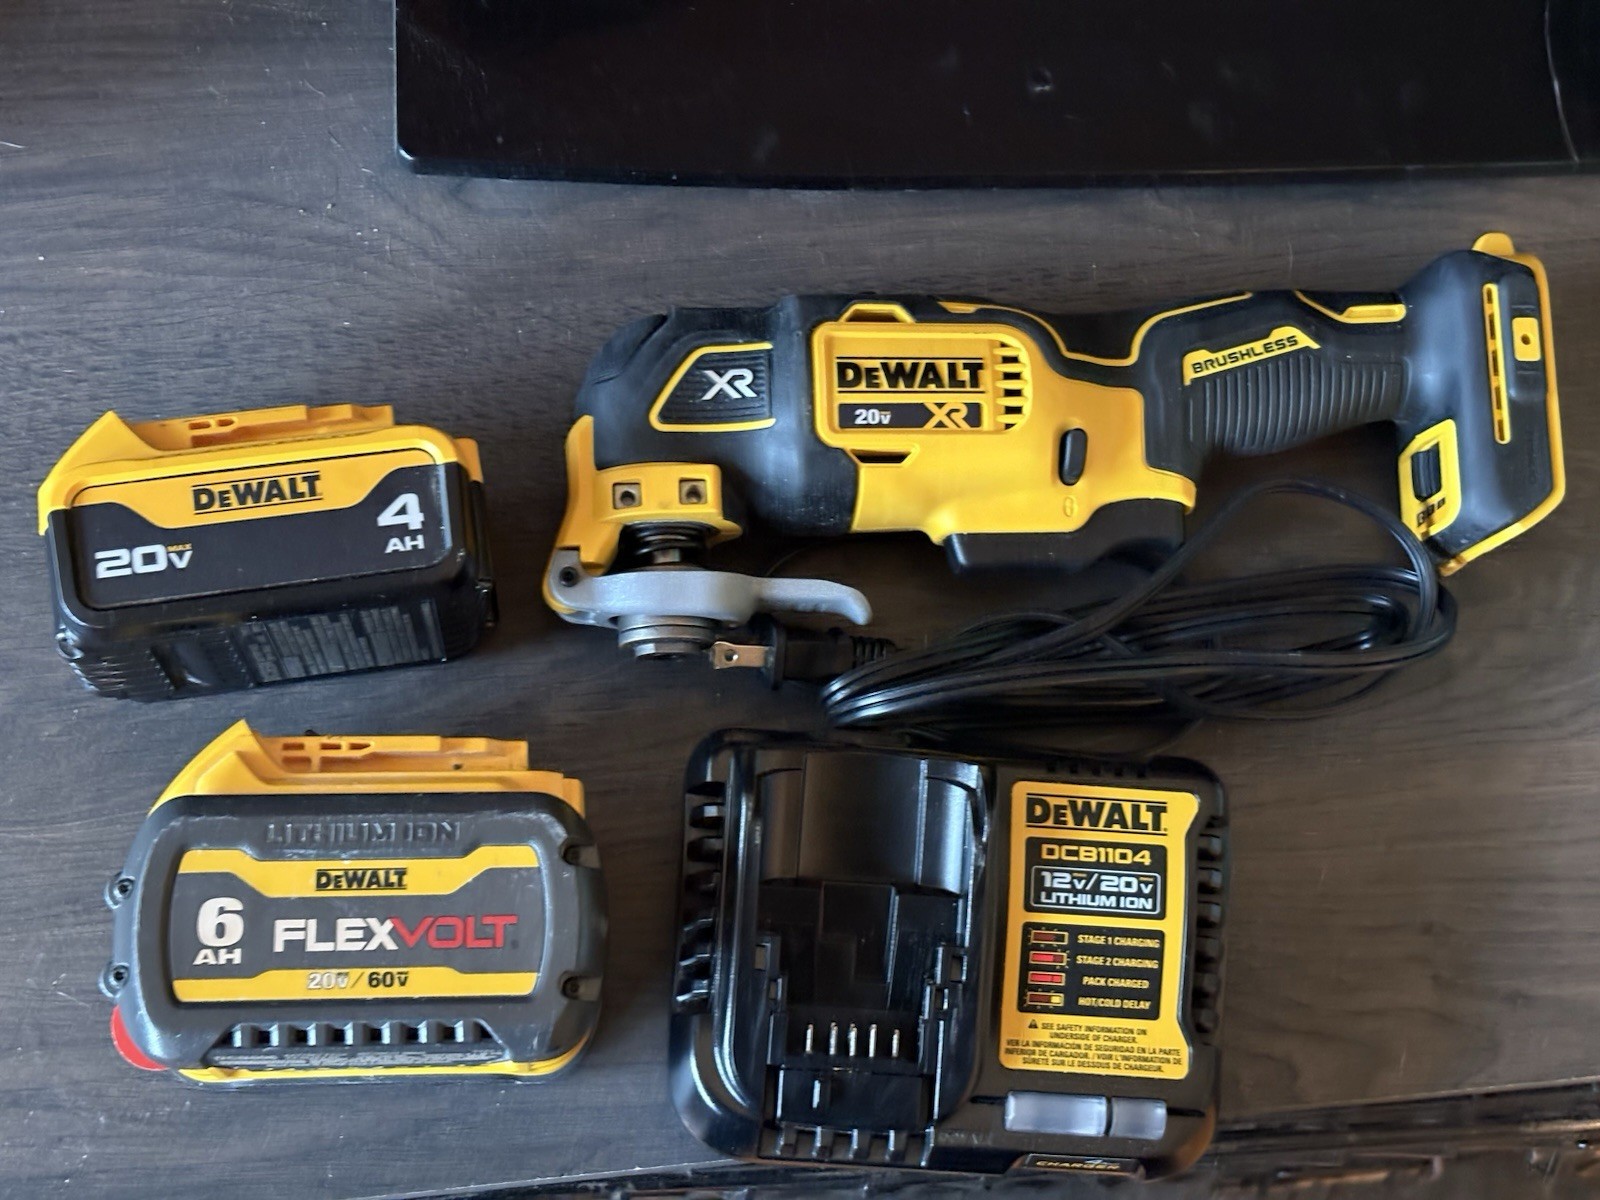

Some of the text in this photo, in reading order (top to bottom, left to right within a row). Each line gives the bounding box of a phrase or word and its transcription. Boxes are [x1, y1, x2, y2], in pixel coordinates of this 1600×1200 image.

[1191, 335, 1298, 374] BRUSHLESS
[701, 368, 755, 400] XR
[922, 401, 972, 430] XR
[377, 492, 425, 531] 4
[385, 534, 425, 554] AH
[265, 820, 461, 844] LITHIUM ION
[1041, 843, 1152, 866] DCB1104
[1041, 891, 1153, 910] LITHIUM ION
[196, 897, 244, 948] 6
[273, 914, 518, 953] FLEXVOLT
[1077, 934, 1160, 948] STAGE 1 CHARGING
[193, 948, 242, 965] AH
[1076, 955, 1159, 969] STAGE 2 CHARGING
[1082, 976, 1149, 989] PACK CHARGED
[1078, 997, 1151, 1010] HOT/COLD DELAY
[1050, 1032, 1090, 1040] UNDERSIDE
[1056, 1023, 1082, 1031] SAFETY
[1084, 1025, 1134, 1034] INFORMATION
[1095, 1044, 1135, 1053] SEGURIDAD
[1137, 1046, 1146, 1054] EN
[1148, 1047, 1157, 1055] LA
[1159, 1048, 1180, 1056] PARTE
[1052, 1058, 1066, 1067] SUR
[1077, 1060, 1110, 1069] DESSOUS
